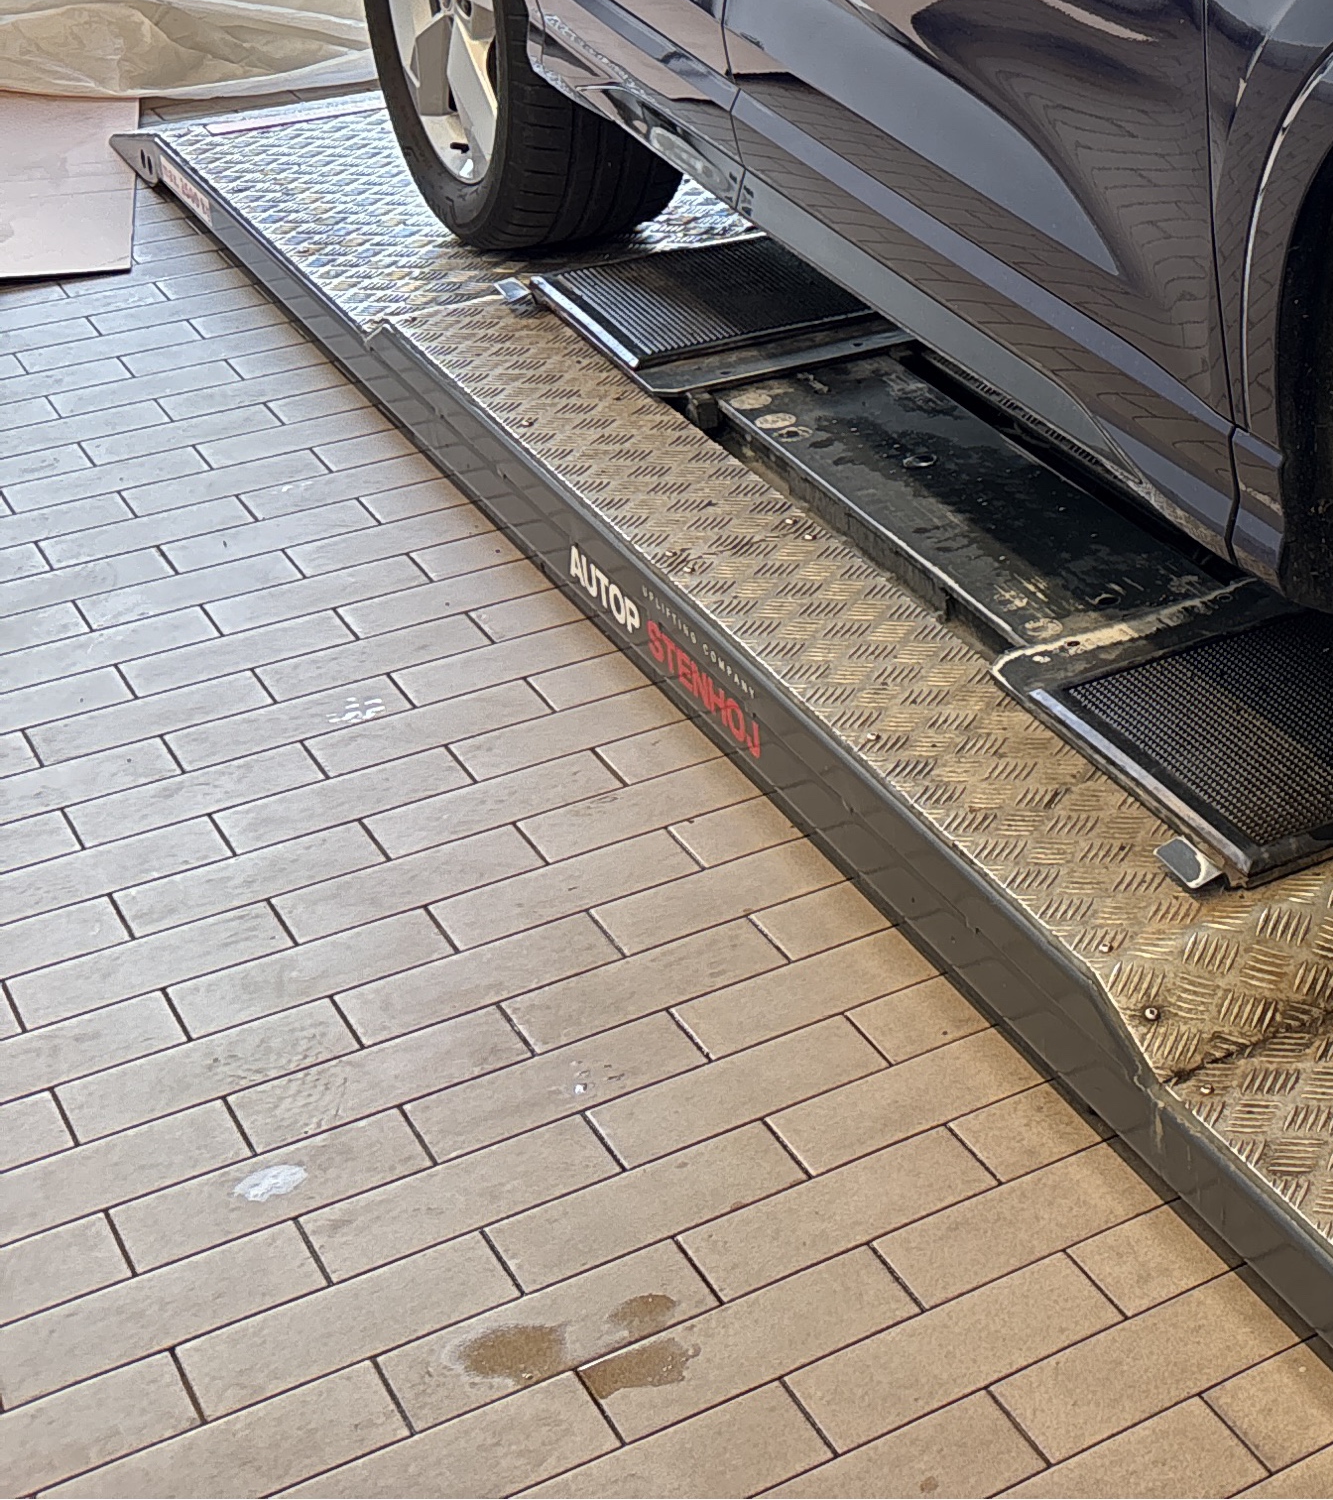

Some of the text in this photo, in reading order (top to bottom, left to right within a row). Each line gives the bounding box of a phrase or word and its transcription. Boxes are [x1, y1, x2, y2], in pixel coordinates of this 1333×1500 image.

[570, 545, 761, 759] AUTOP STENHOJ
[641, 584, 756, 699] UPLIFTING COMPANY
